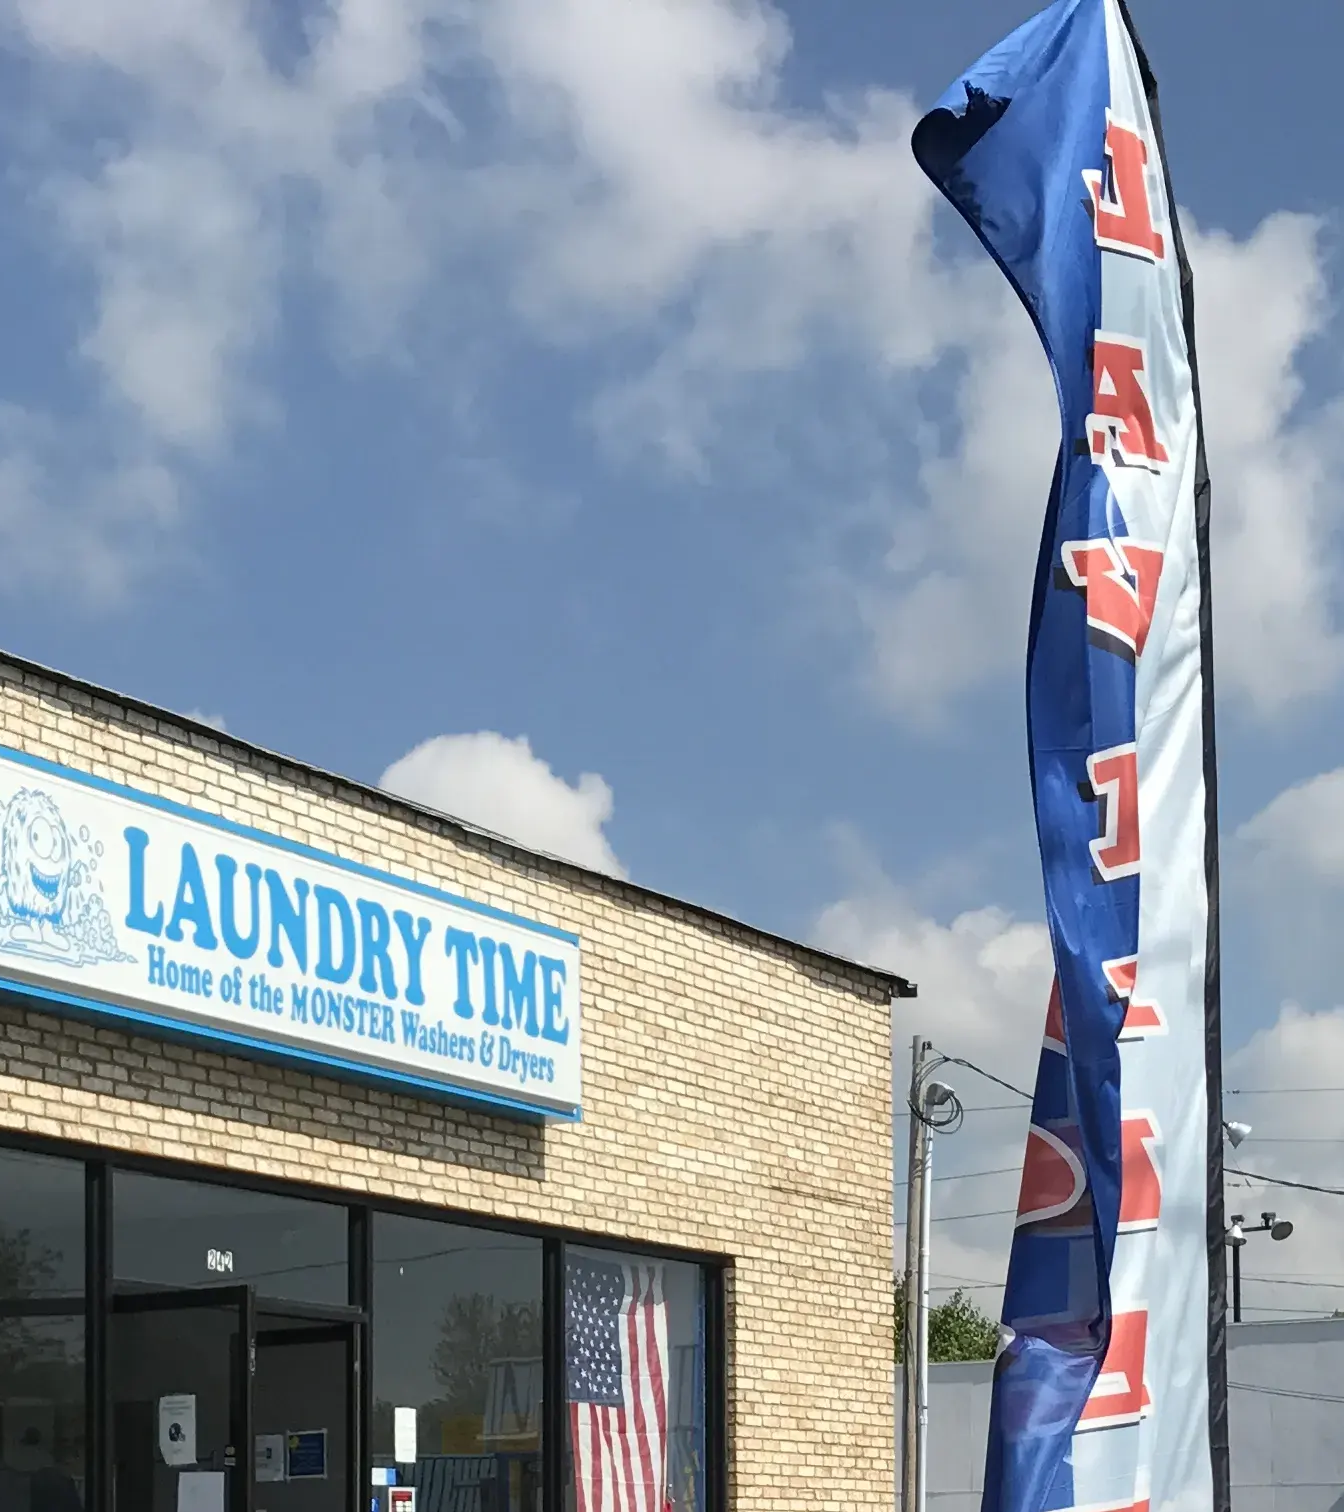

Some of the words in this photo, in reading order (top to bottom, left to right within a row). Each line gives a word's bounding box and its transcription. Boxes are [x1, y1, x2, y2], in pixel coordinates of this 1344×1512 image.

[123, 826, 431, 1005] LAUNDRY
[445, 926, 570, 1045] TIME
[147, 944, 214, 999] Home
[221, 967, 244, 1005] of
[248, 975, 284, 1015] the
[291, 984, 396, 1045] MONSTER
[400, 1012, 475, 1063] Washers
[478, 1033, 495, 1066] &
[497, 1035, 555, 1083] Dryers
